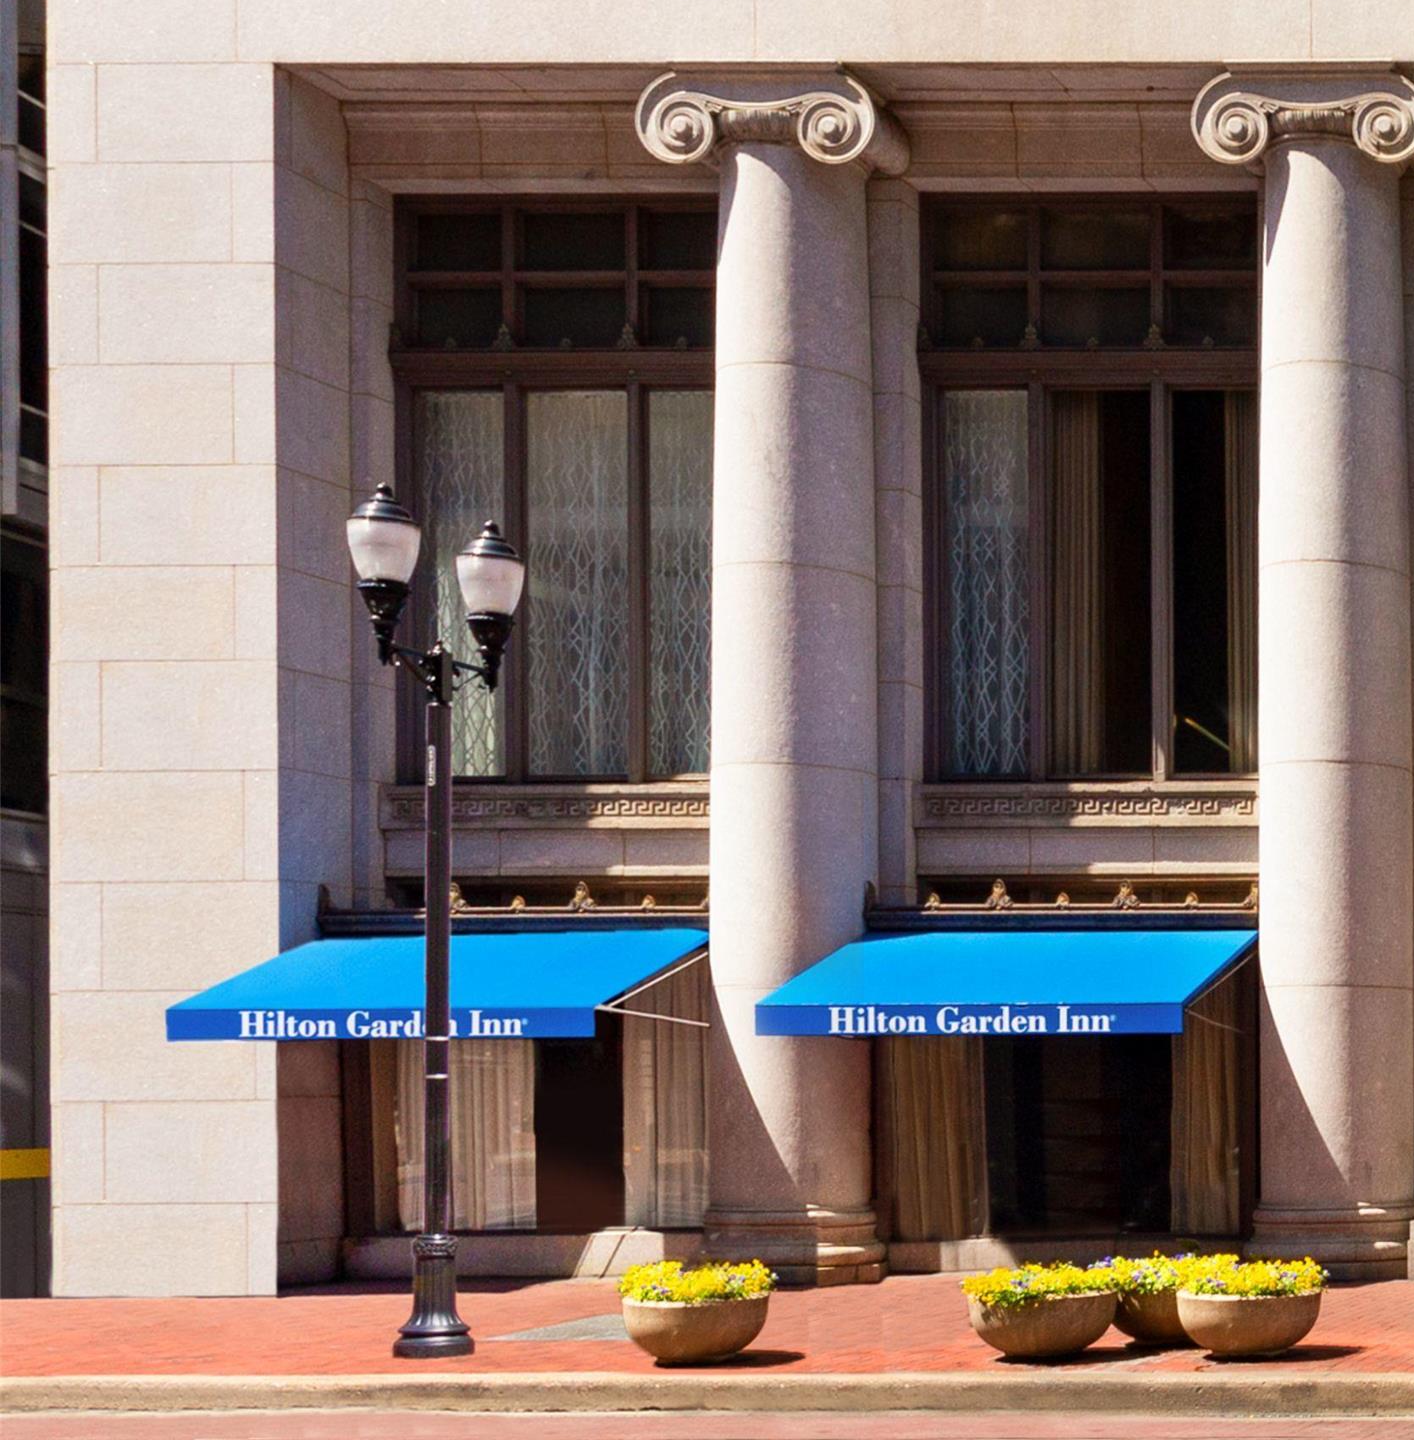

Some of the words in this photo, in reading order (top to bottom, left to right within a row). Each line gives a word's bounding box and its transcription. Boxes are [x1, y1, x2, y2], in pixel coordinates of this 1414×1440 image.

[239, 1010, 337, 1037] Hilton
[468, 1009, 523, 1037] Inn
[828, 1006, 926, 1034] Hilton
[936, 1005, 1047, 1034] Garden
[1056, 1005, 1111, 1033] Inn
